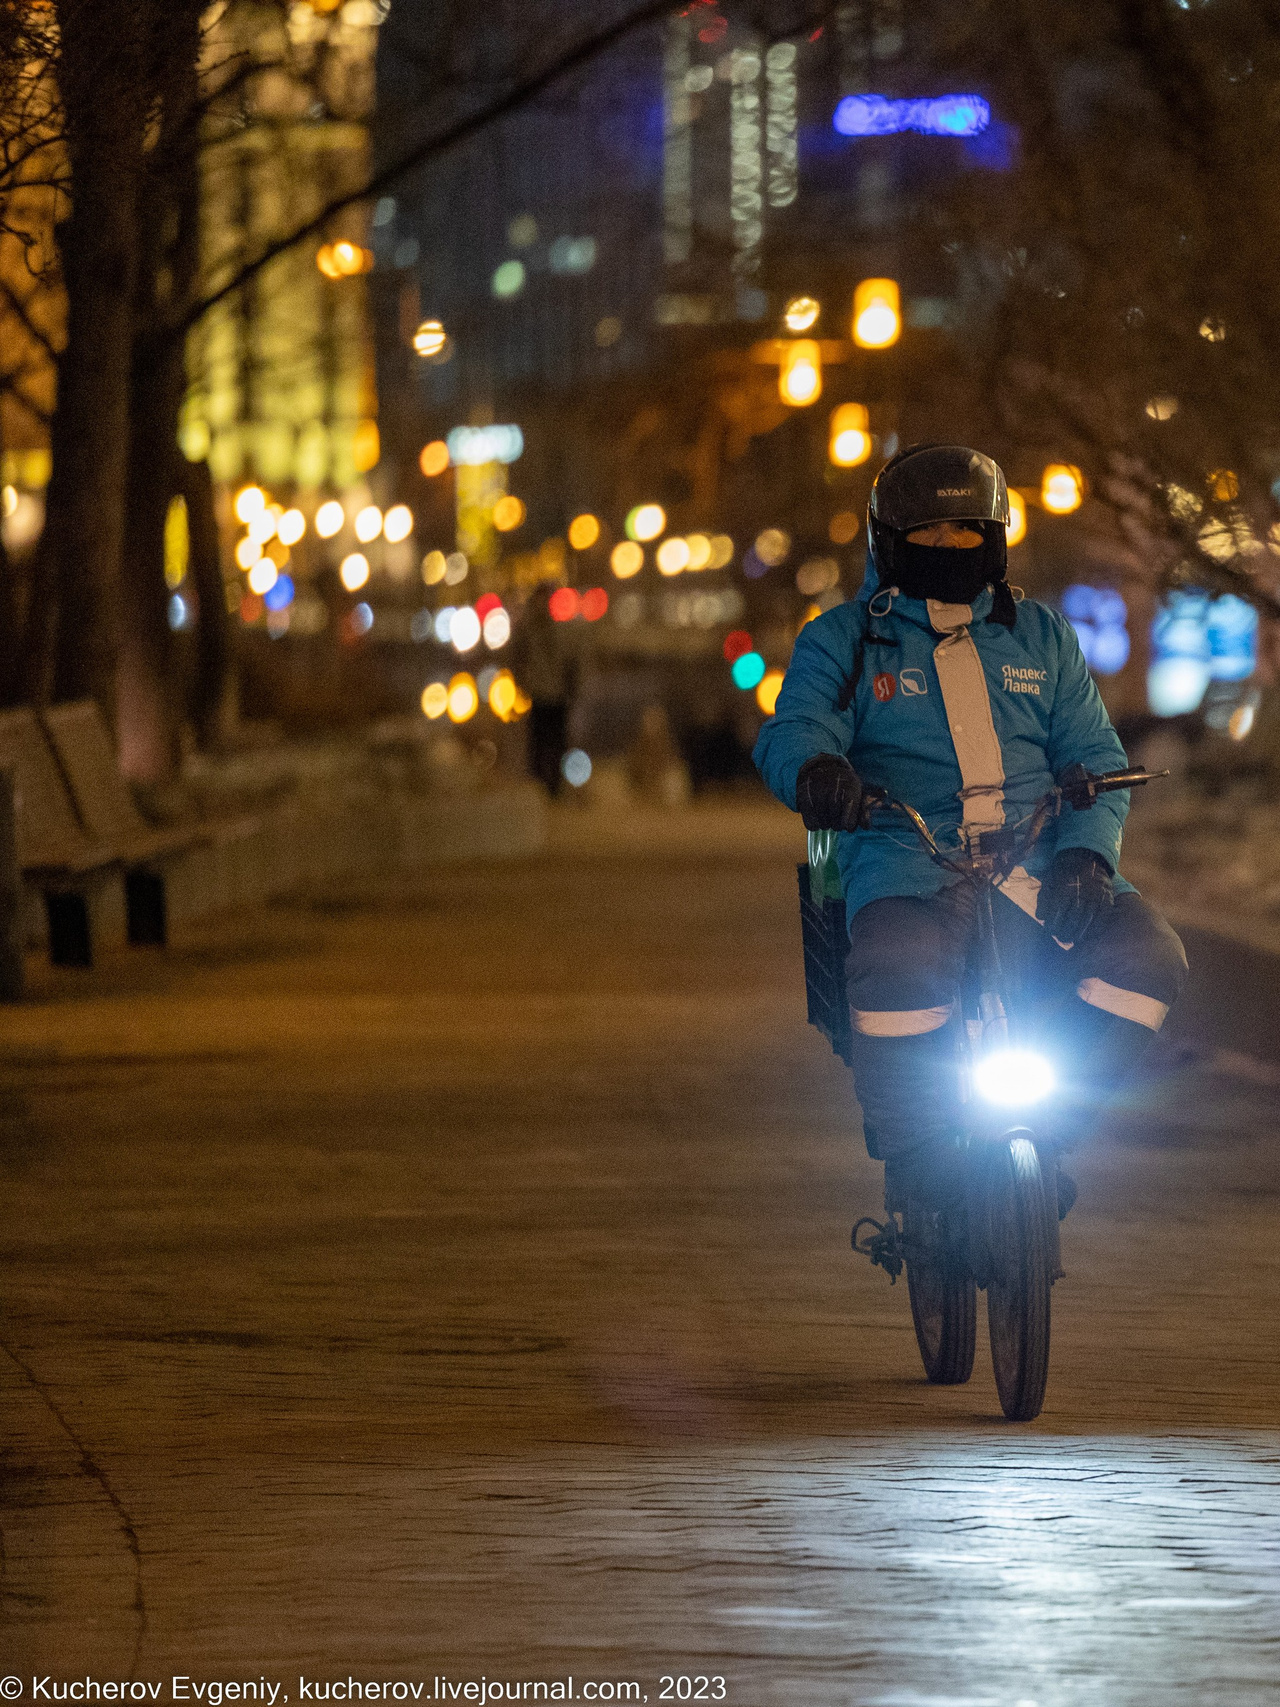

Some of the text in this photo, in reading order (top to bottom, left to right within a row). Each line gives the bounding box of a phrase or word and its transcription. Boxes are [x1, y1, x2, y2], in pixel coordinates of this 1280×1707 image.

[1001, 664, 1047, 681] Яндекс
[878, 677, 889, 697] Я
[1003, 678, 1040, 695] Лавка
